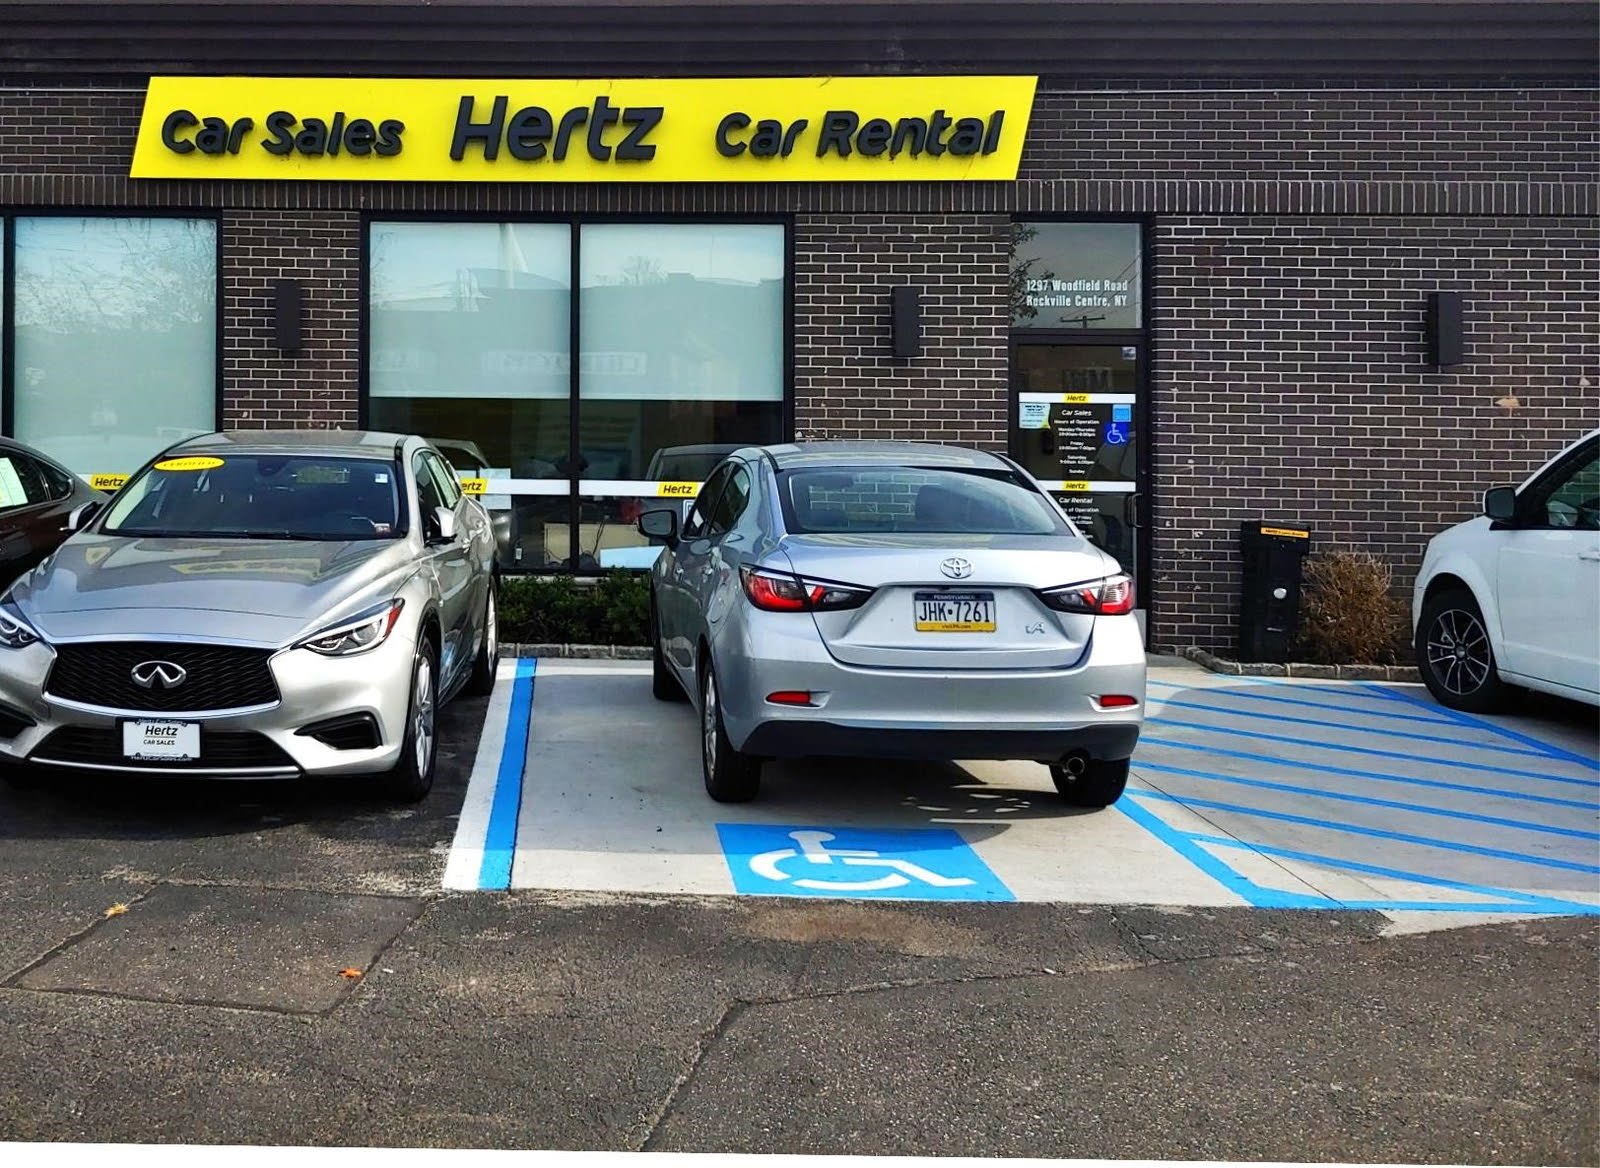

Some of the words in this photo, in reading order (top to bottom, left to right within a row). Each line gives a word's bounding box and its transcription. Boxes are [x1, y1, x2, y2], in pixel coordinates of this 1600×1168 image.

[161, 109, 254, 156] Car
[261, 110, 406, 157] Sales
[449, 95, 665, 162] Hertz
[715, 111, 809, 158] Car
[816, 109, 1006, 159] Rental
[1026, 279, 1048, 291] 1297
[1052, 279, 1101, 291] Woodfield
[1104, 279, 1128, 291] Road
[1026, 295, 1072, 307] Rockville
[1074, 295, 1111, 308] Centre,
[1114, 295, 1128, 307] NY
[1066, 394, 1087, 402] Hertz
[1074, 409, 1093, 417] Sales
[94, 477, 125, 487] Hertz
[461, 481, 483, 491] ertz
[1065, 482, 1086, 490] Hertz
[663, 484, 693, 494] Hertz
[1071, 496, 1093, 504] Rental
[145, 725, 178, 736] Hertz
